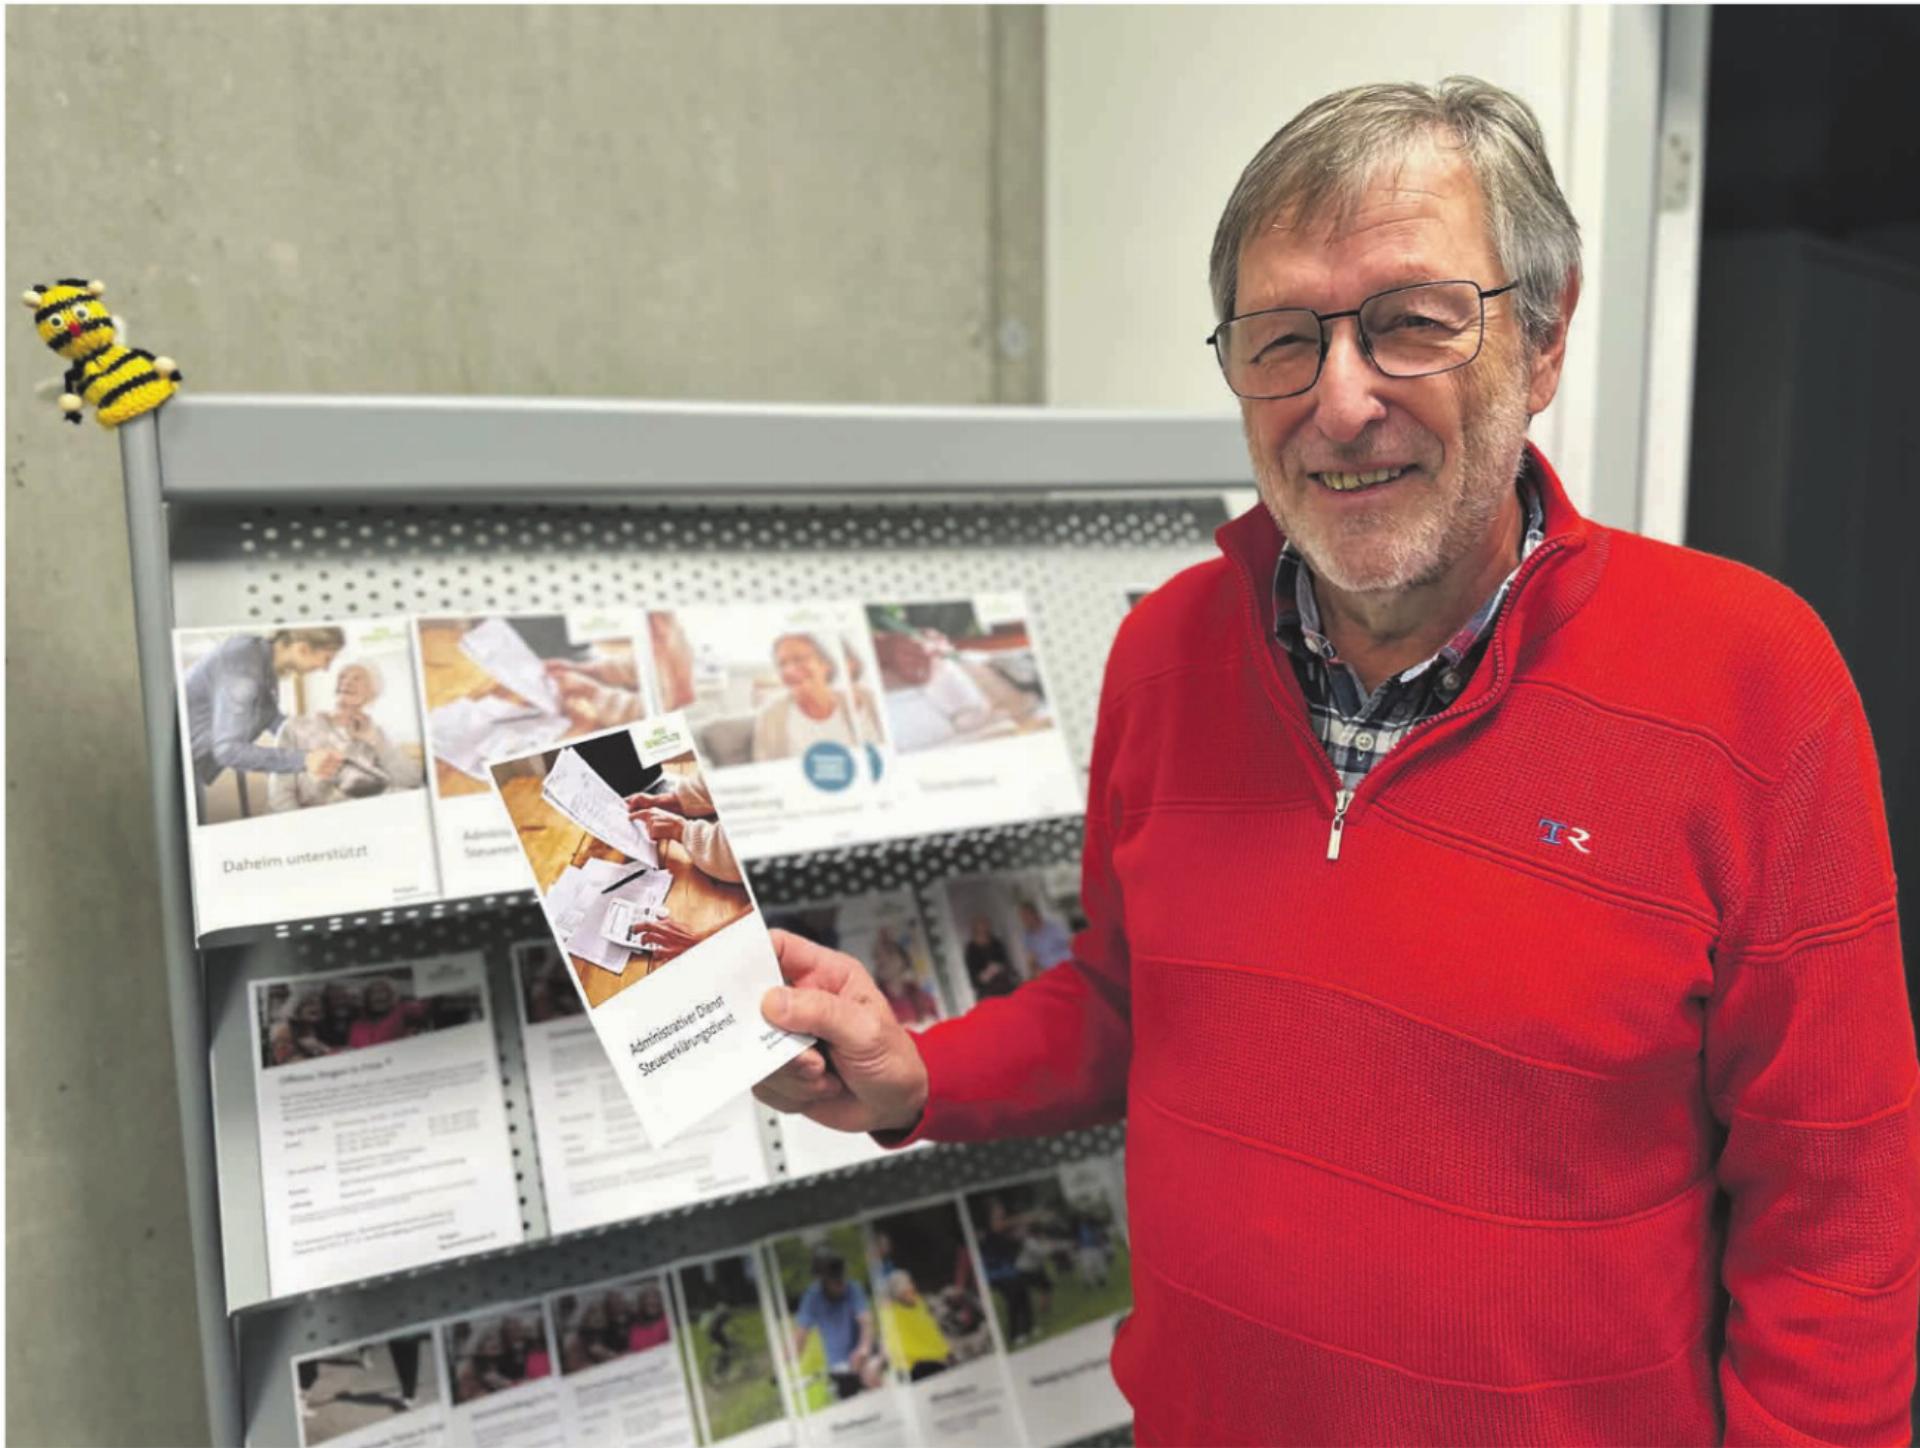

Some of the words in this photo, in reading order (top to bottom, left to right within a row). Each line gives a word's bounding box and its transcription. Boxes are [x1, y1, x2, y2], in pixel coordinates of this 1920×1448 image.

[223, 856, 283, 874] Daheim
[286, 845, 368, 865] unterstützt
[630, 1011, 696, 1056] Administrativer
[695, 995, 725, 1019] Dienst
[638, 1013, 736, 1077] Steuererklärungsdienst
